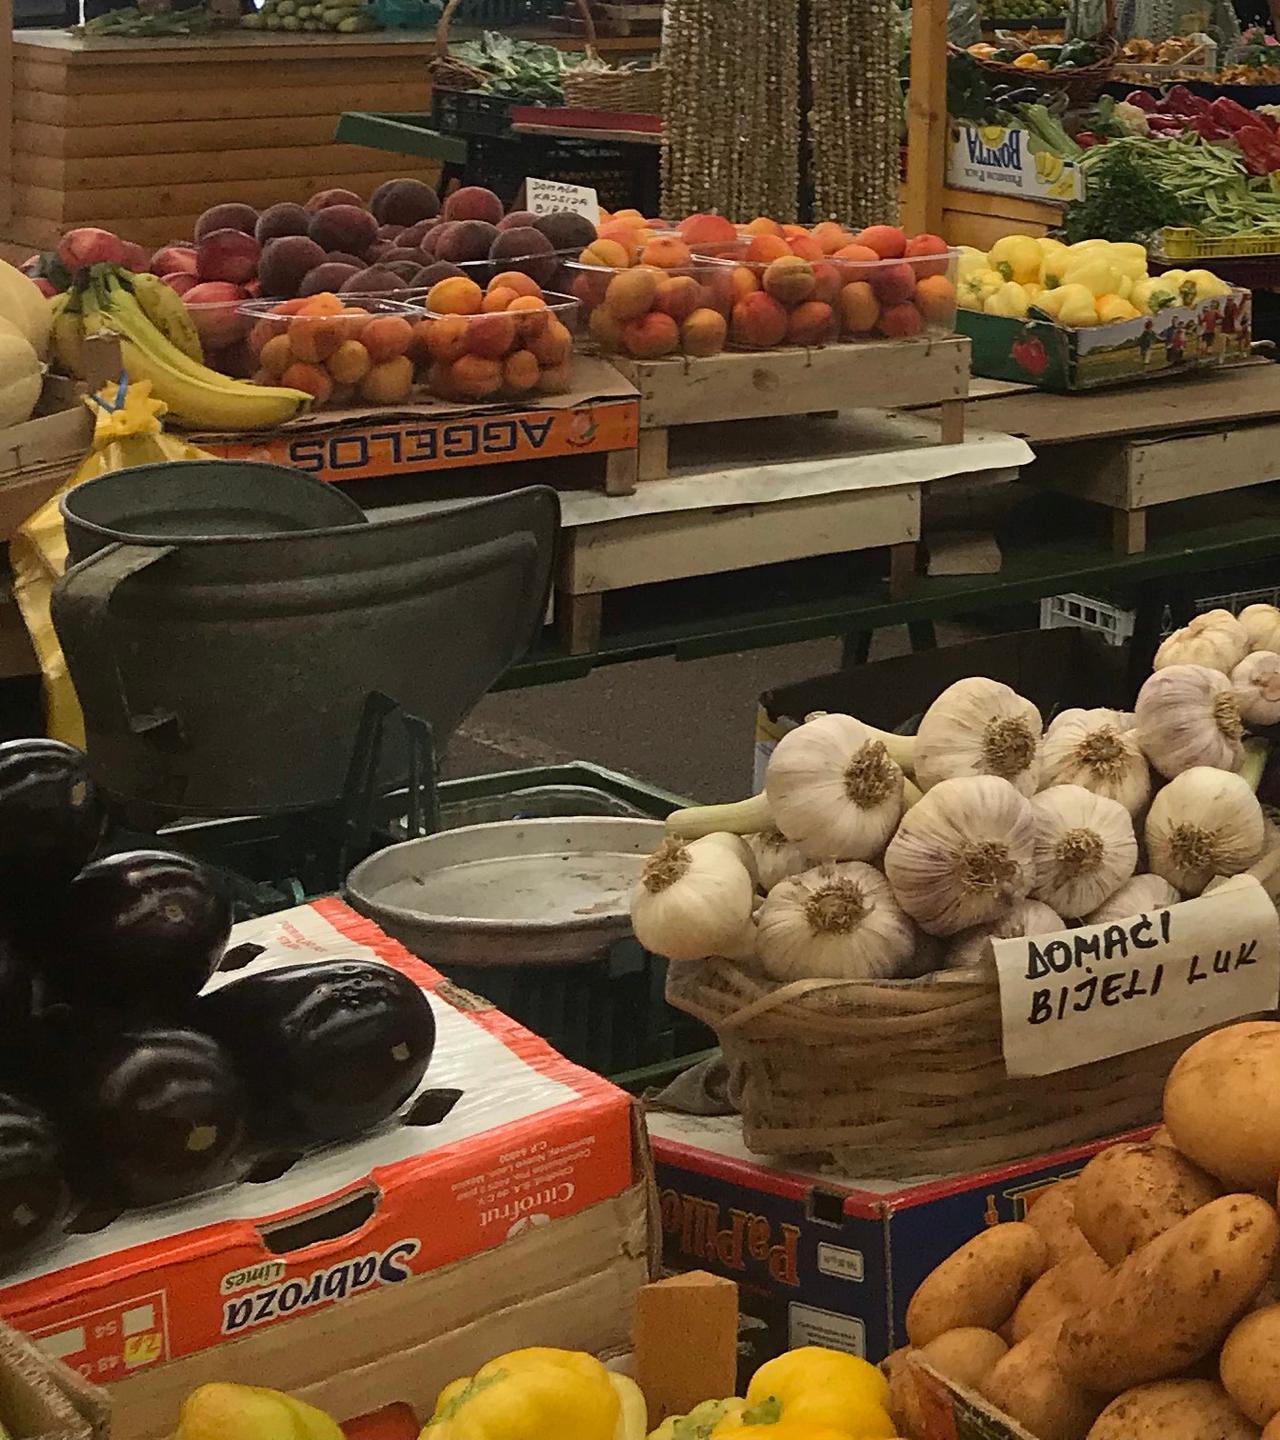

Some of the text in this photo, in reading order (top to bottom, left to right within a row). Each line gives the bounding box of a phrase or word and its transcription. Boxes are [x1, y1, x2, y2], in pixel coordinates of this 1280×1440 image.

[287, 415, 556, 473] AGGELOS
[1024, 910, 1171, 980] DOMAĆI
[1027, 939, 1258, 1025] BIJELI LUK
[479, 1182, 575, 1227] Citrofrut
[222, 1240, 420, 1333] Sabroza
[224, 1262, 282, 1290] Limes
